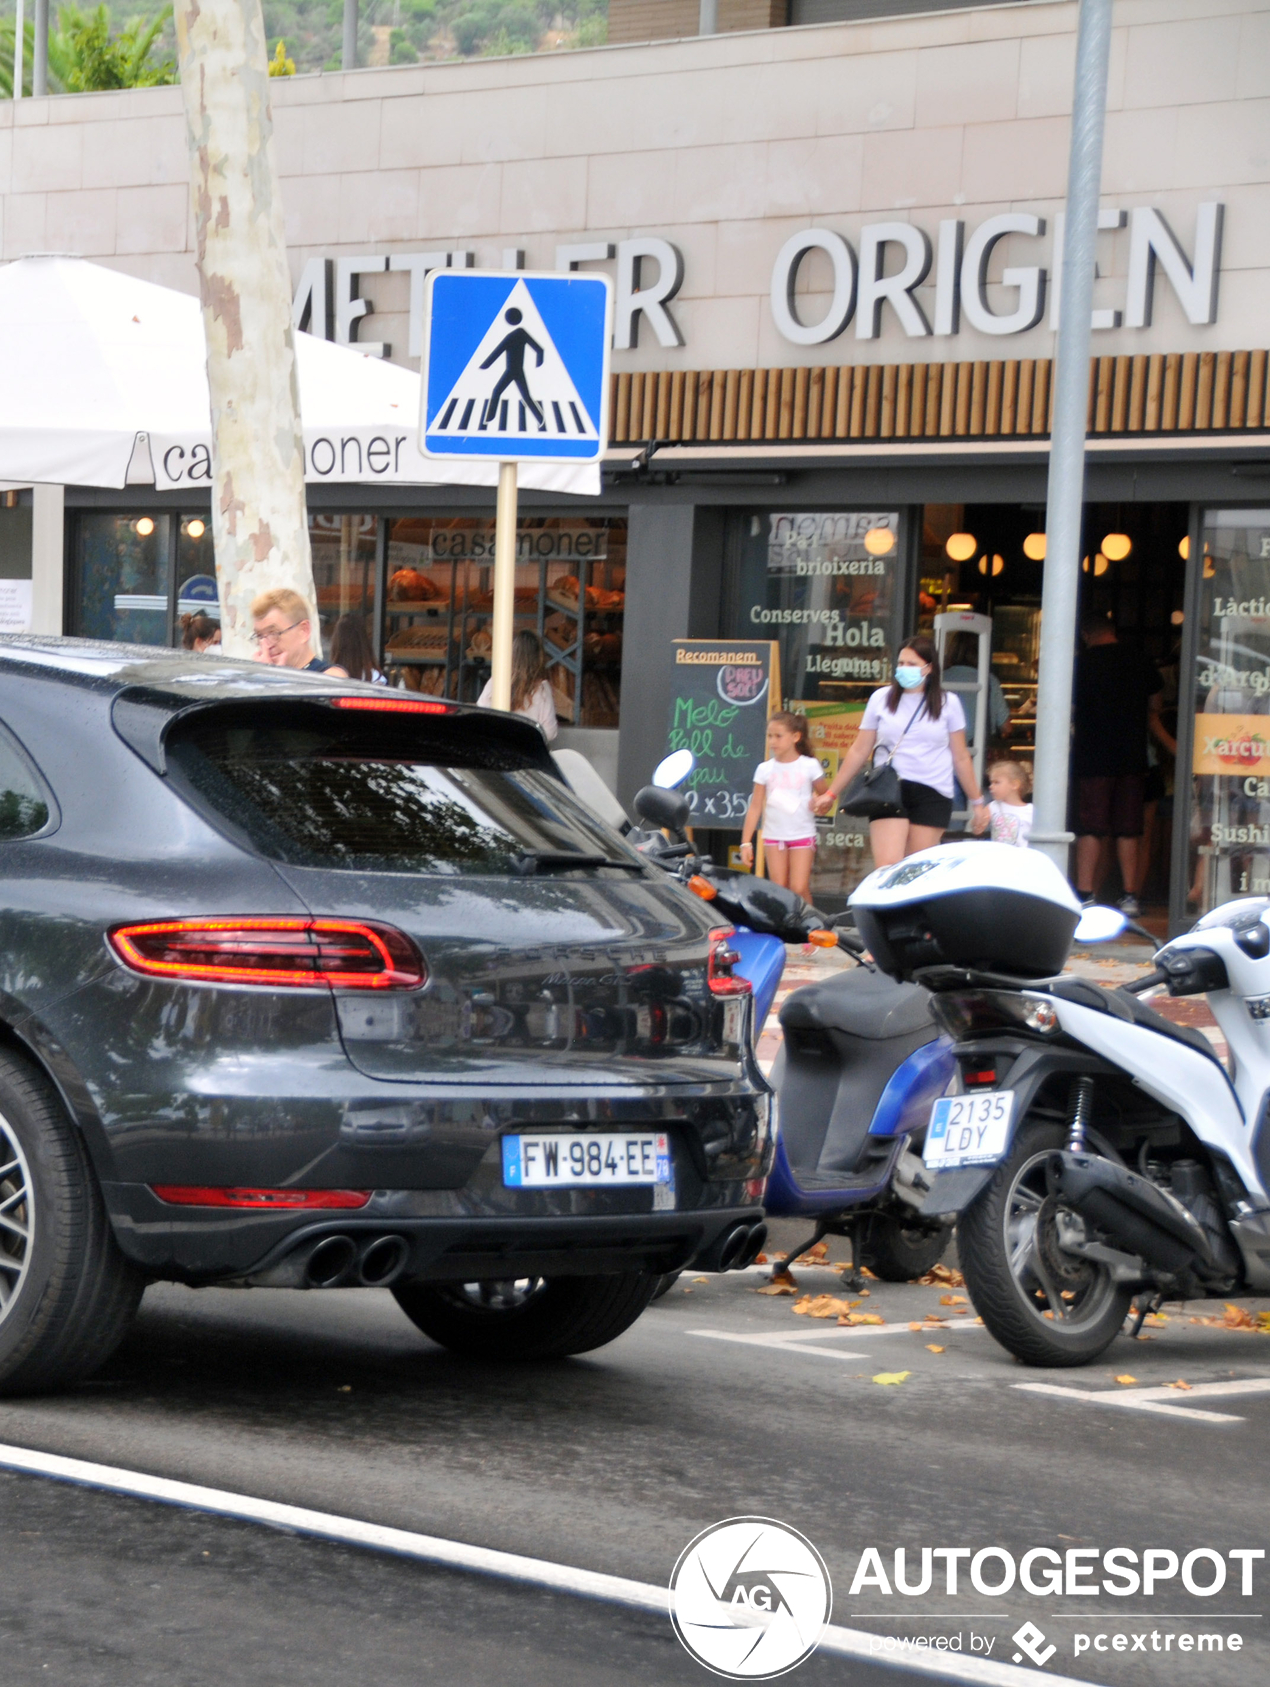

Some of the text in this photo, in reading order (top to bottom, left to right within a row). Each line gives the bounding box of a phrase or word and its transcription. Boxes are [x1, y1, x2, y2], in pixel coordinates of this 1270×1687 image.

[770, 202, 1225, 346] ORIGEN
[796, 556, 885, 576] brioixeria
[750, 605, 840, 624] Conserves
[825, 620, 885, 647] Hola
[676, 648, 758, 664] Recomanem
[805, 654, 881, 677] Llegums
[721, 732, 750, 758] de
[826, 832, 865, 848] seca
[949, 1096, 1005, 1126] 2135
[944, 1125, 988, 1152] LDY
[509, 1165, 516, 1177] F
